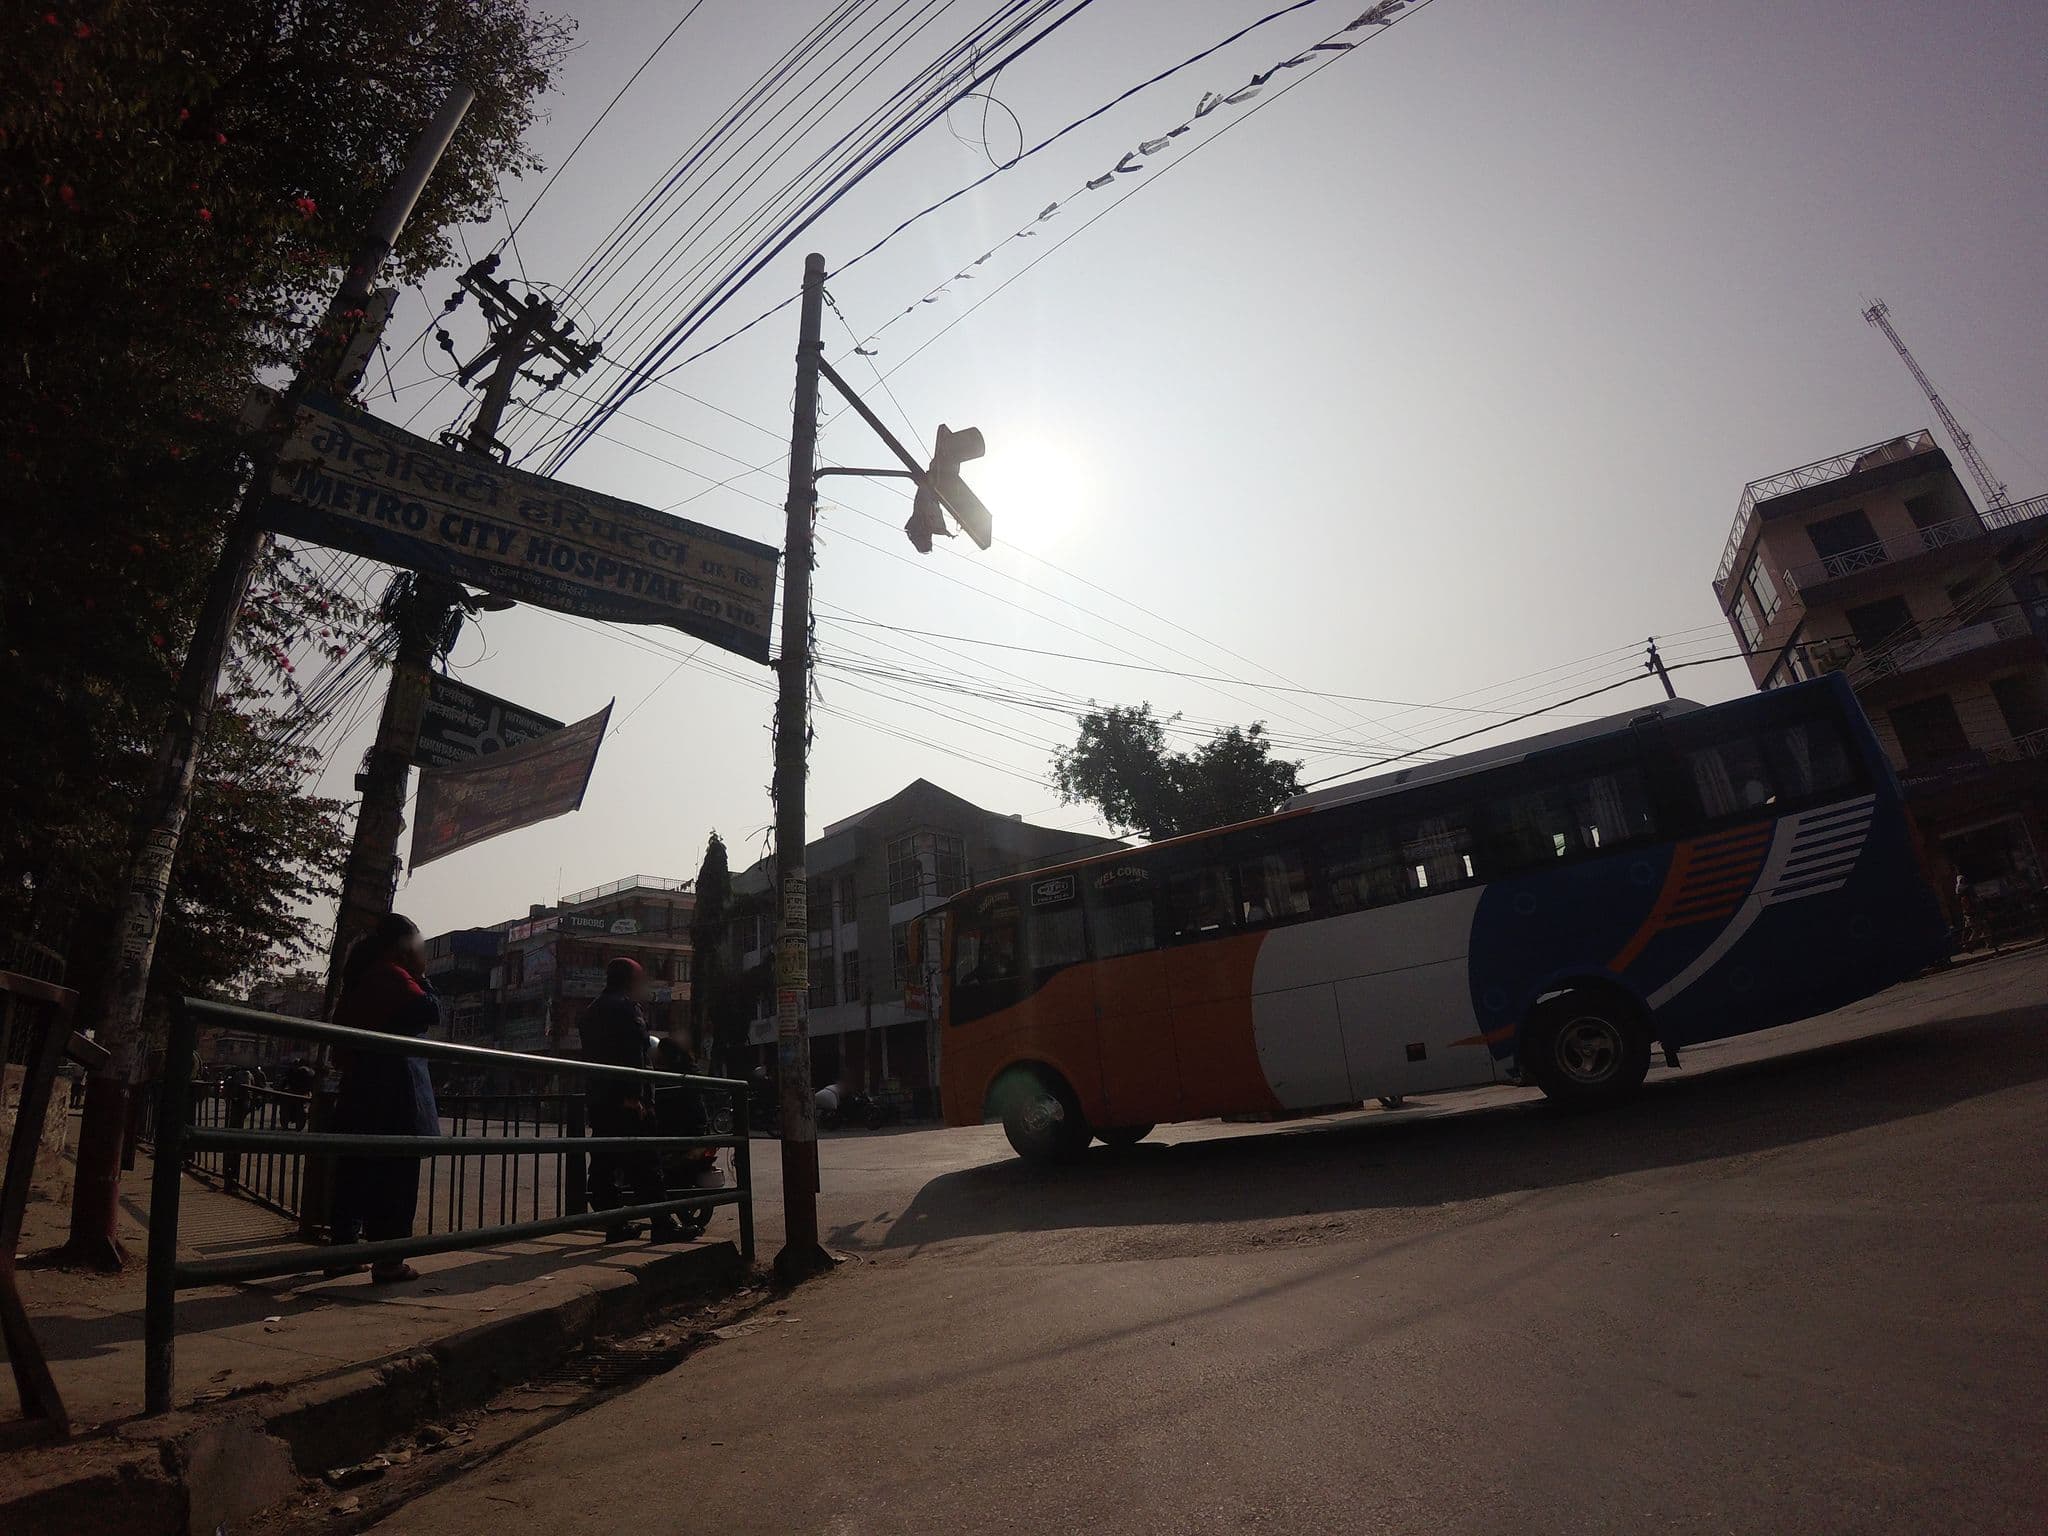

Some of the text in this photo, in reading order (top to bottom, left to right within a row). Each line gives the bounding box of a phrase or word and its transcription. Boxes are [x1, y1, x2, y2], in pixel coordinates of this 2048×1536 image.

[294, 466, 428, 531] METRO
[440, 509, 518, 555] CITY
[528, 533, 684, 599] HOSPITAL
[570, 916, 605, 928] TUBORG
